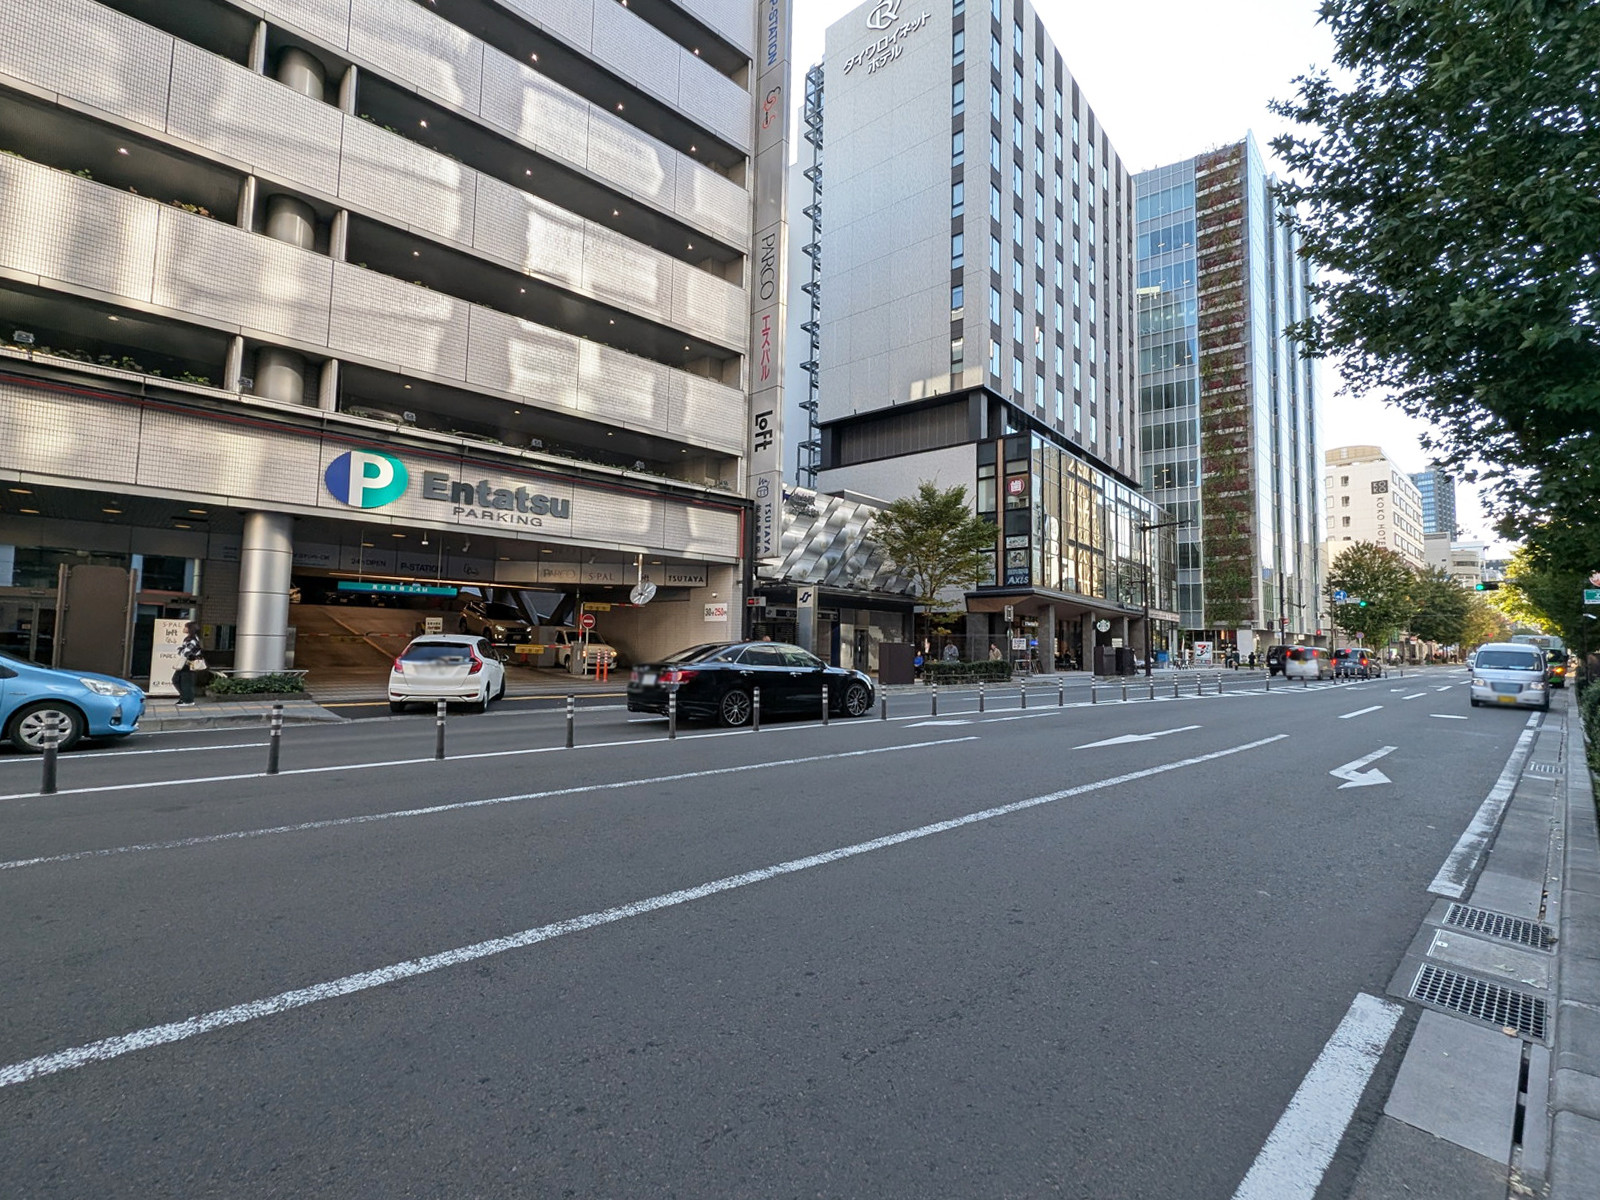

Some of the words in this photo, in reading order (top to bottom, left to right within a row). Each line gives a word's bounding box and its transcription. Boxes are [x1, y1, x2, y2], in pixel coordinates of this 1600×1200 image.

[867, 45, 904, 74] ホテル
[760, 233, 775, 300] PARCO
[348, 450, 394, 507] P
[423, 470, 570, 518] Entatsu
[1376, 497, 1385, 520] KOKO
[453, 507, 543, 527] PARKING
[763, 502, 772, 554] TSUTAYA
[1377, 524, 1386, 545] HOTE
[668, 575, 704, 583] TSUTAYA
